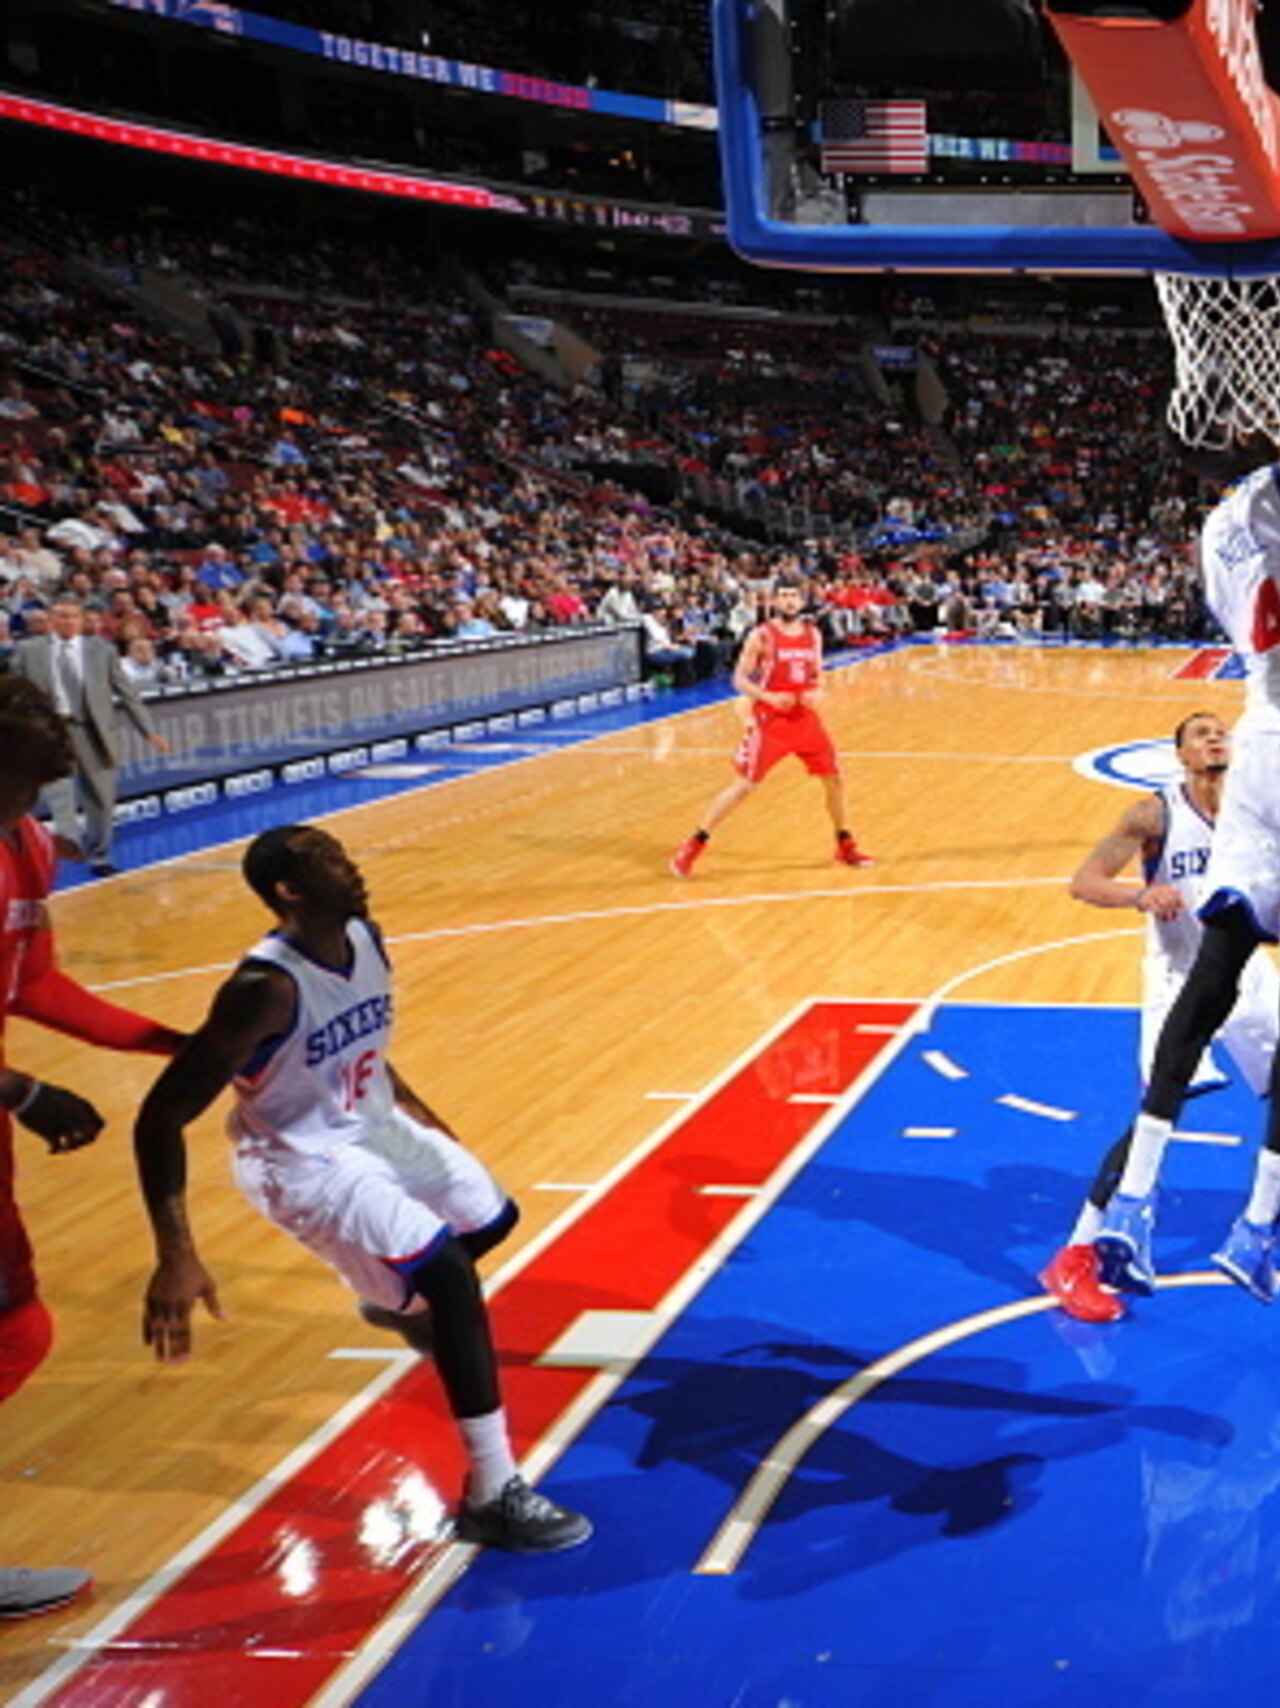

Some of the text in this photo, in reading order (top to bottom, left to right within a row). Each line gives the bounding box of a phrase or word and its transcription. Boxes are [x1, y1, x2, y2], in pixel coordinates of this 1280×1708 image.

[319, 31, 451, 83] TOGETHER
[457, 62, 496, 92] WE
[212, 687, 344, 760] TICKETS
[349, 681, 385, 732] ON
[390, 670, 448, 723] SALE
[1170, 846, 1212, 880] SIX
